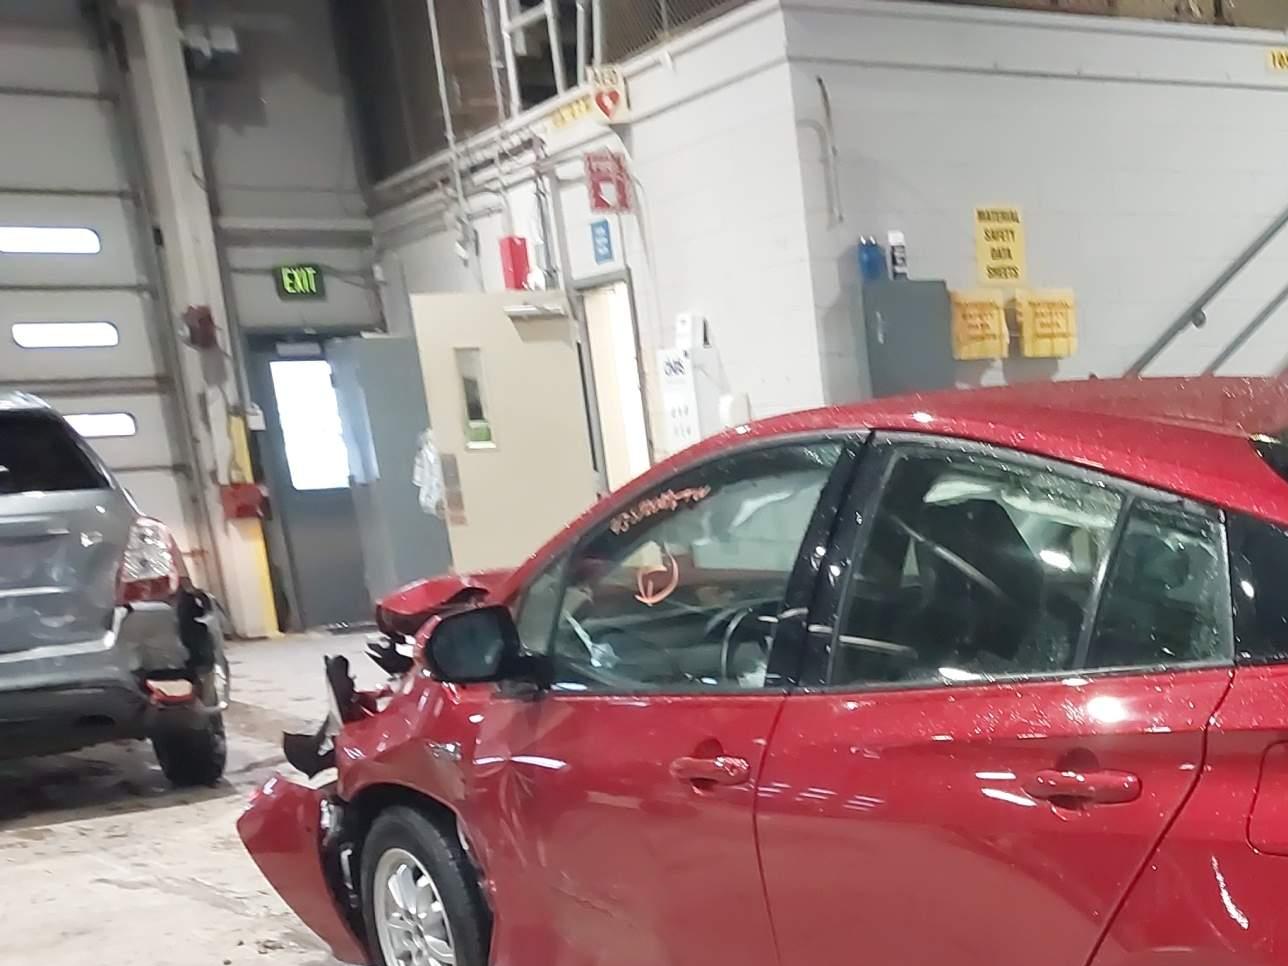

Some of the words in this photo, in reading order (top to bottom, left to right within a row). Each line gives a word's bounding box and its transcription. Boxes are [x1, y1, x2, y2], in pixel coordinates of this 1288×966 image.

[977, 210, 1020, 223] MATERIAL
[984, 229, 1015, 242] SAFETY
[991, 248, 1013, 260] DATA
[986, 265, 1020, 280] SHEETS
[281, 266, 317, 294] EXIT
